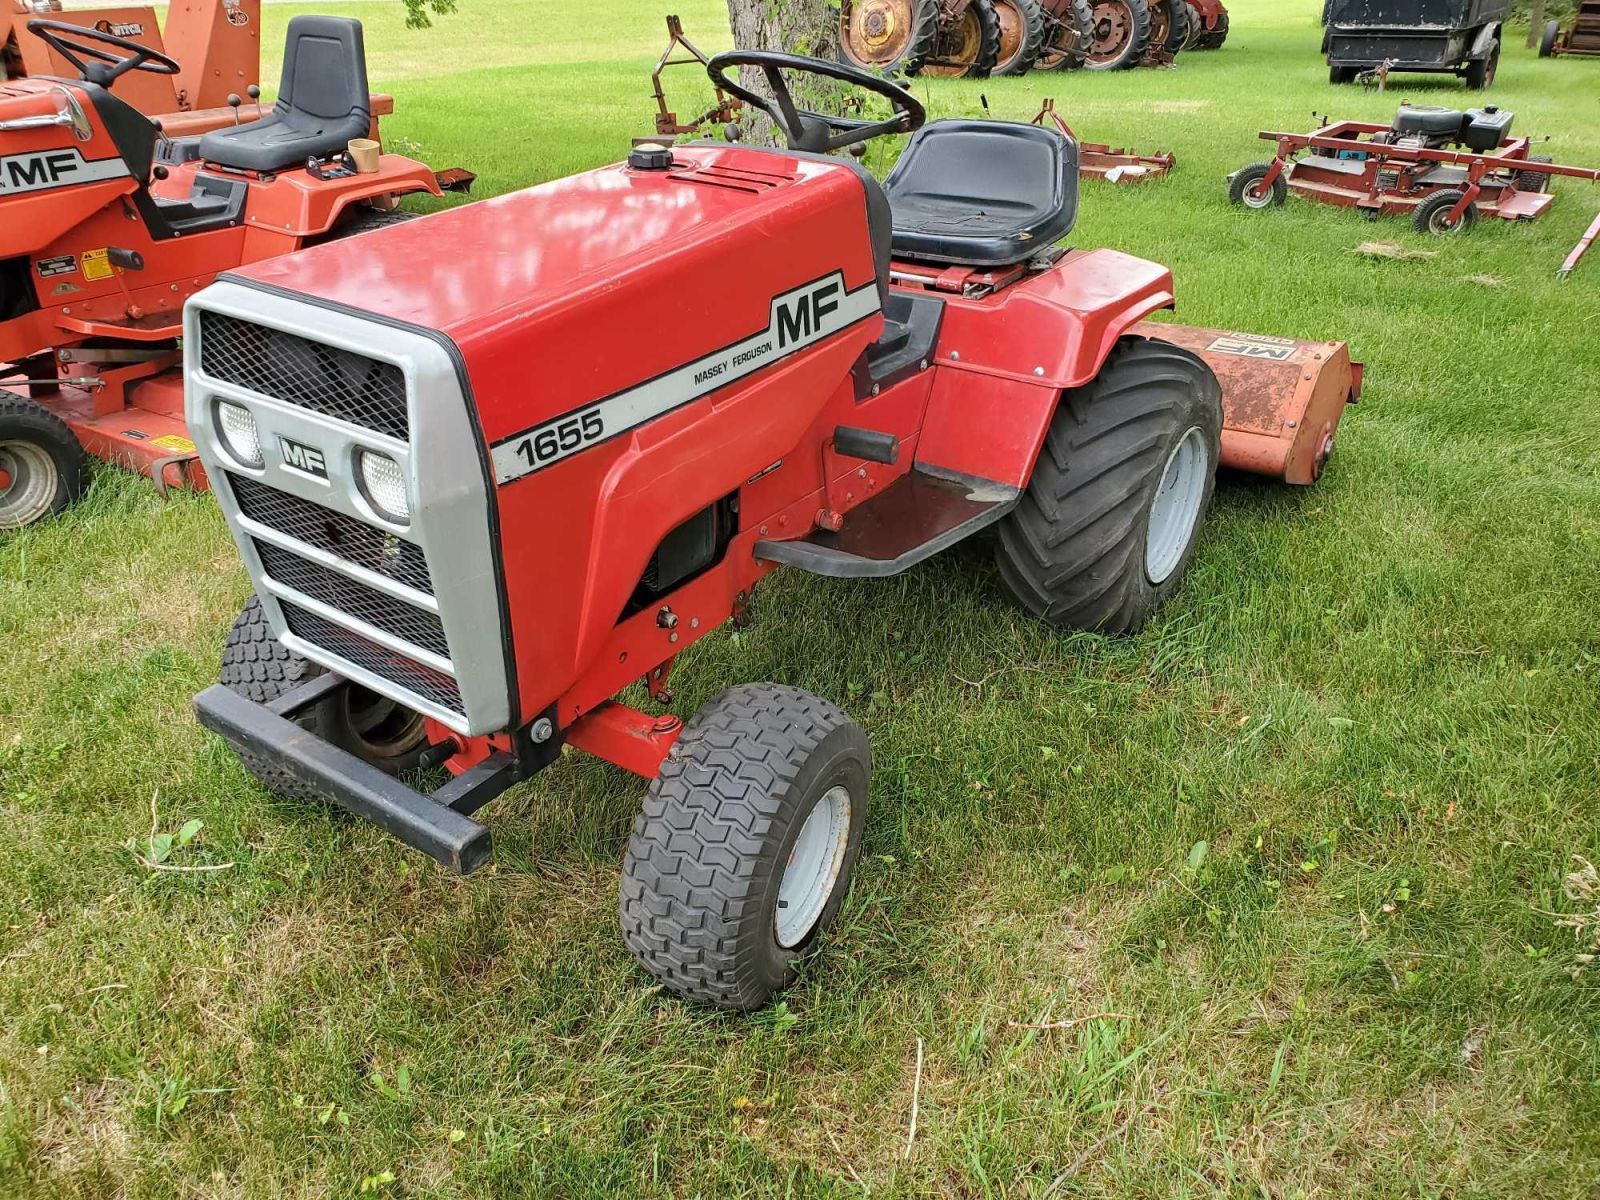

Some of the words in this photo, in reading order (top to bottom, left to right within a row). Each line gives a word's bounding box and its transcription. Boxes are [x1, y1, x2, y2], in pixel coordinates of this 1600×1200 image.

[7, 153, 77, 187] MF
[776, 282, 838, 349] MF
[694, 361, 728, 385] MASSEY
[732, 341, 772, 367] FERGUSON
[281, 440, 325, 472] MF
[516, 408, 604, 467] 1655
